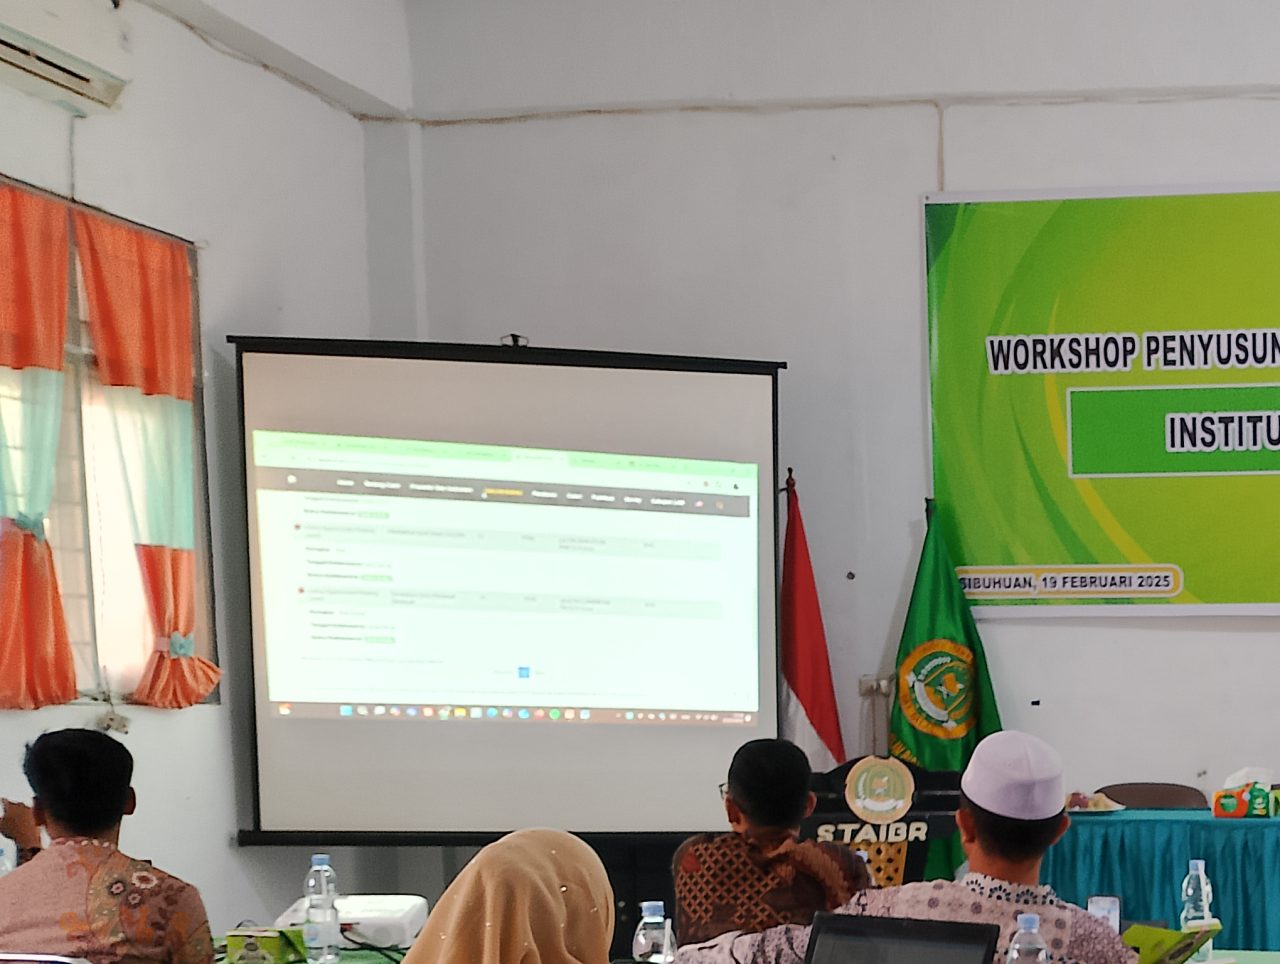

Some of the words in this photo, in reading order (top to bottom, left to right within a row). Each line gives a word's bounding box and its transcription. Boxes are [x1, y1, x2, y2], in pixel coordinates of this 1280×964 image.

[989, 337, 1136, 371] WORKSHOP
[1042, 576, 1058, 589] 19
[1062, 575, 1133, 589] FEBRUARI
[1137, 575, 1171, 588] 2025
